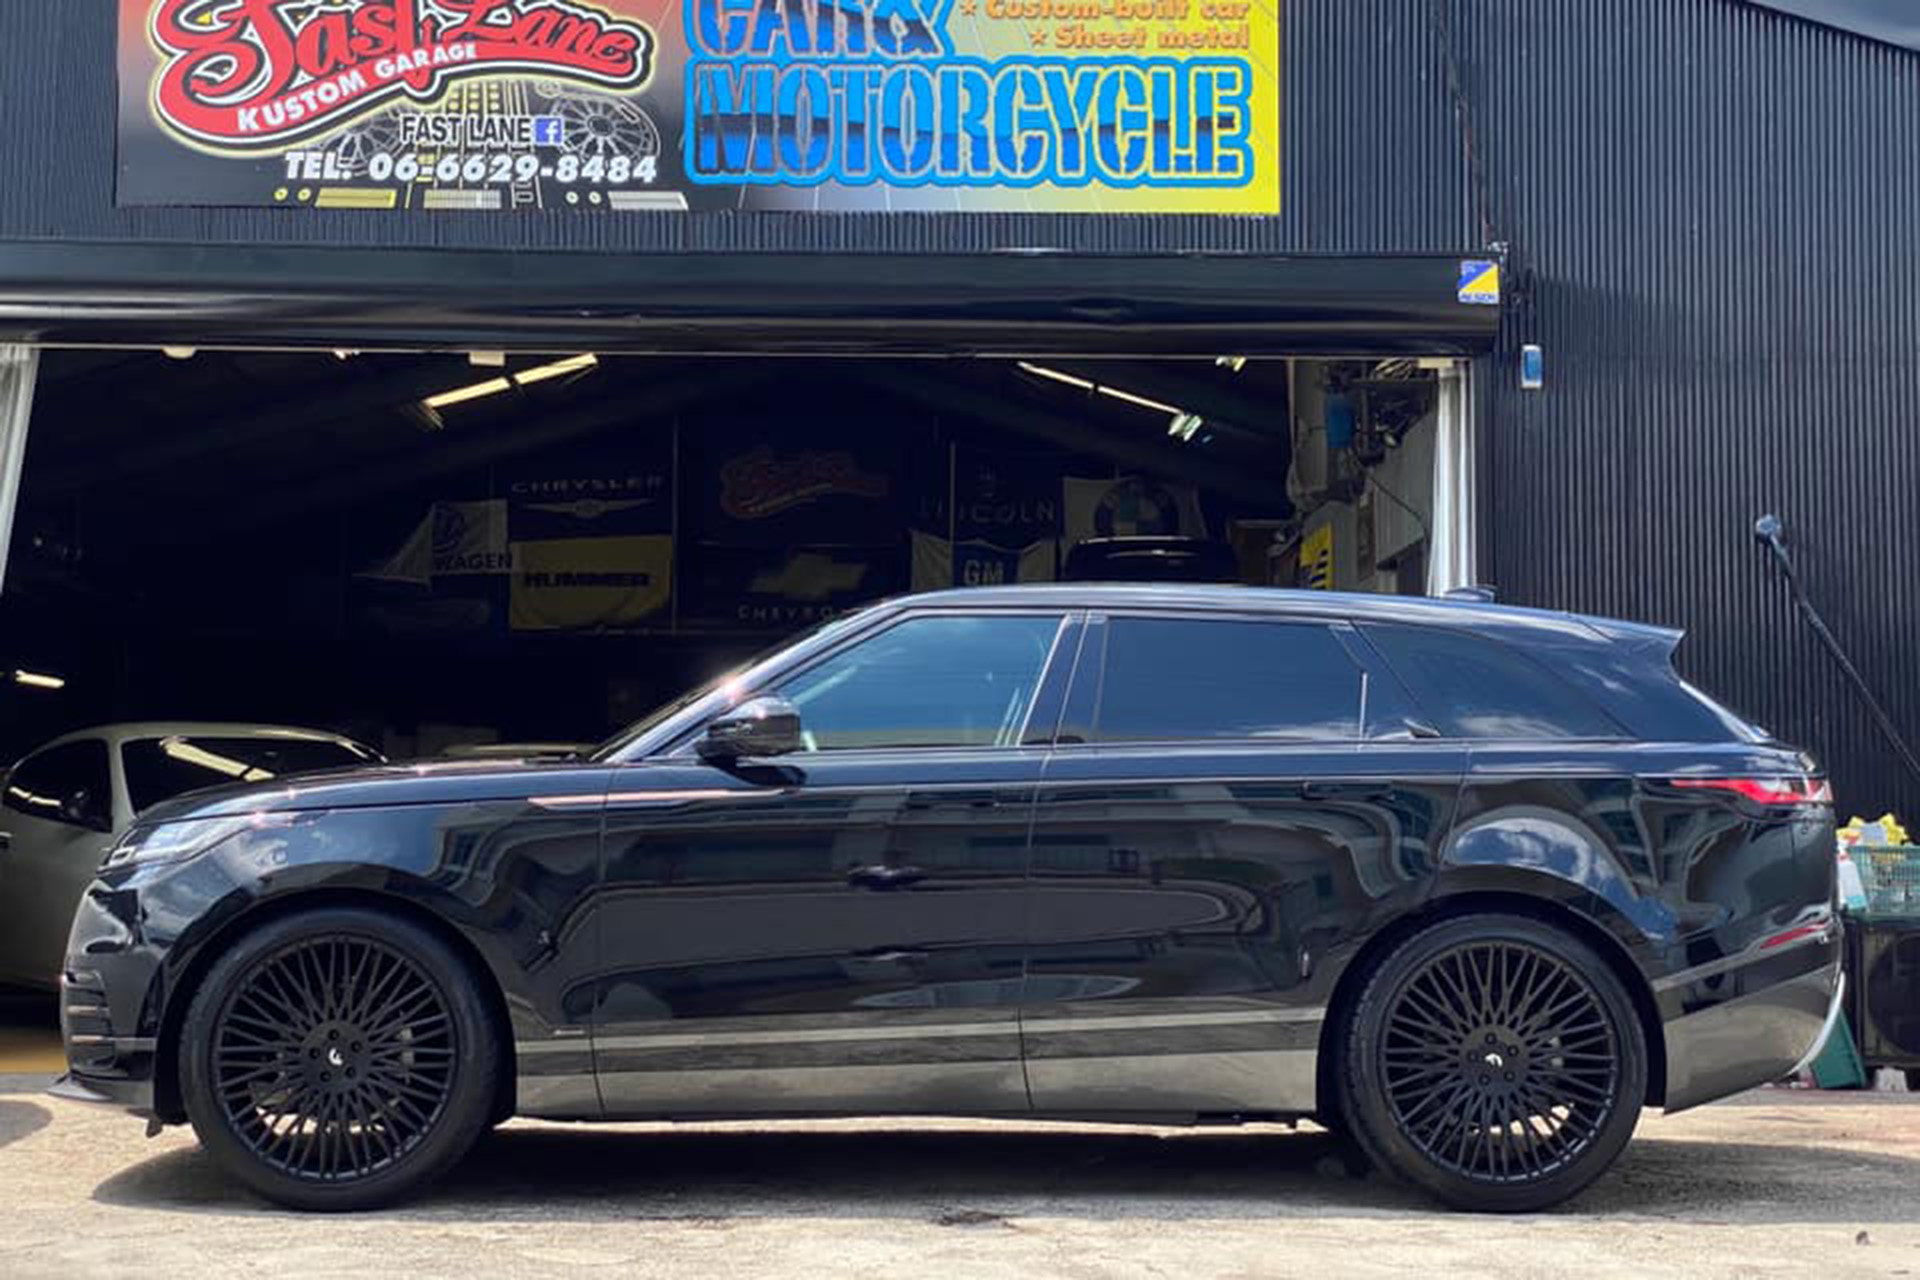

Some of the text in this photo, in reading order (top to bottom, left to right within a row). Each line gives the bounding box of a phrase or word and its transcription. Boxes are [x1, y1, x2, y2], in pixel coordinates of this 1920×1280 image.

[1200, 1, 1250, 19] car
[1055, 23, 1250, 48] Sheet metal
[236, 41, 478, 131] KUSTOM GARAGE
[401, 115, 463, 144] FAST
[468, 115, 533, 144] LANE
[691, 60, 1249, 182] MOTORCYCLE
[367, 154, 659, 184] 06-6629-8484
[963, 558, 1005, 586] GM
